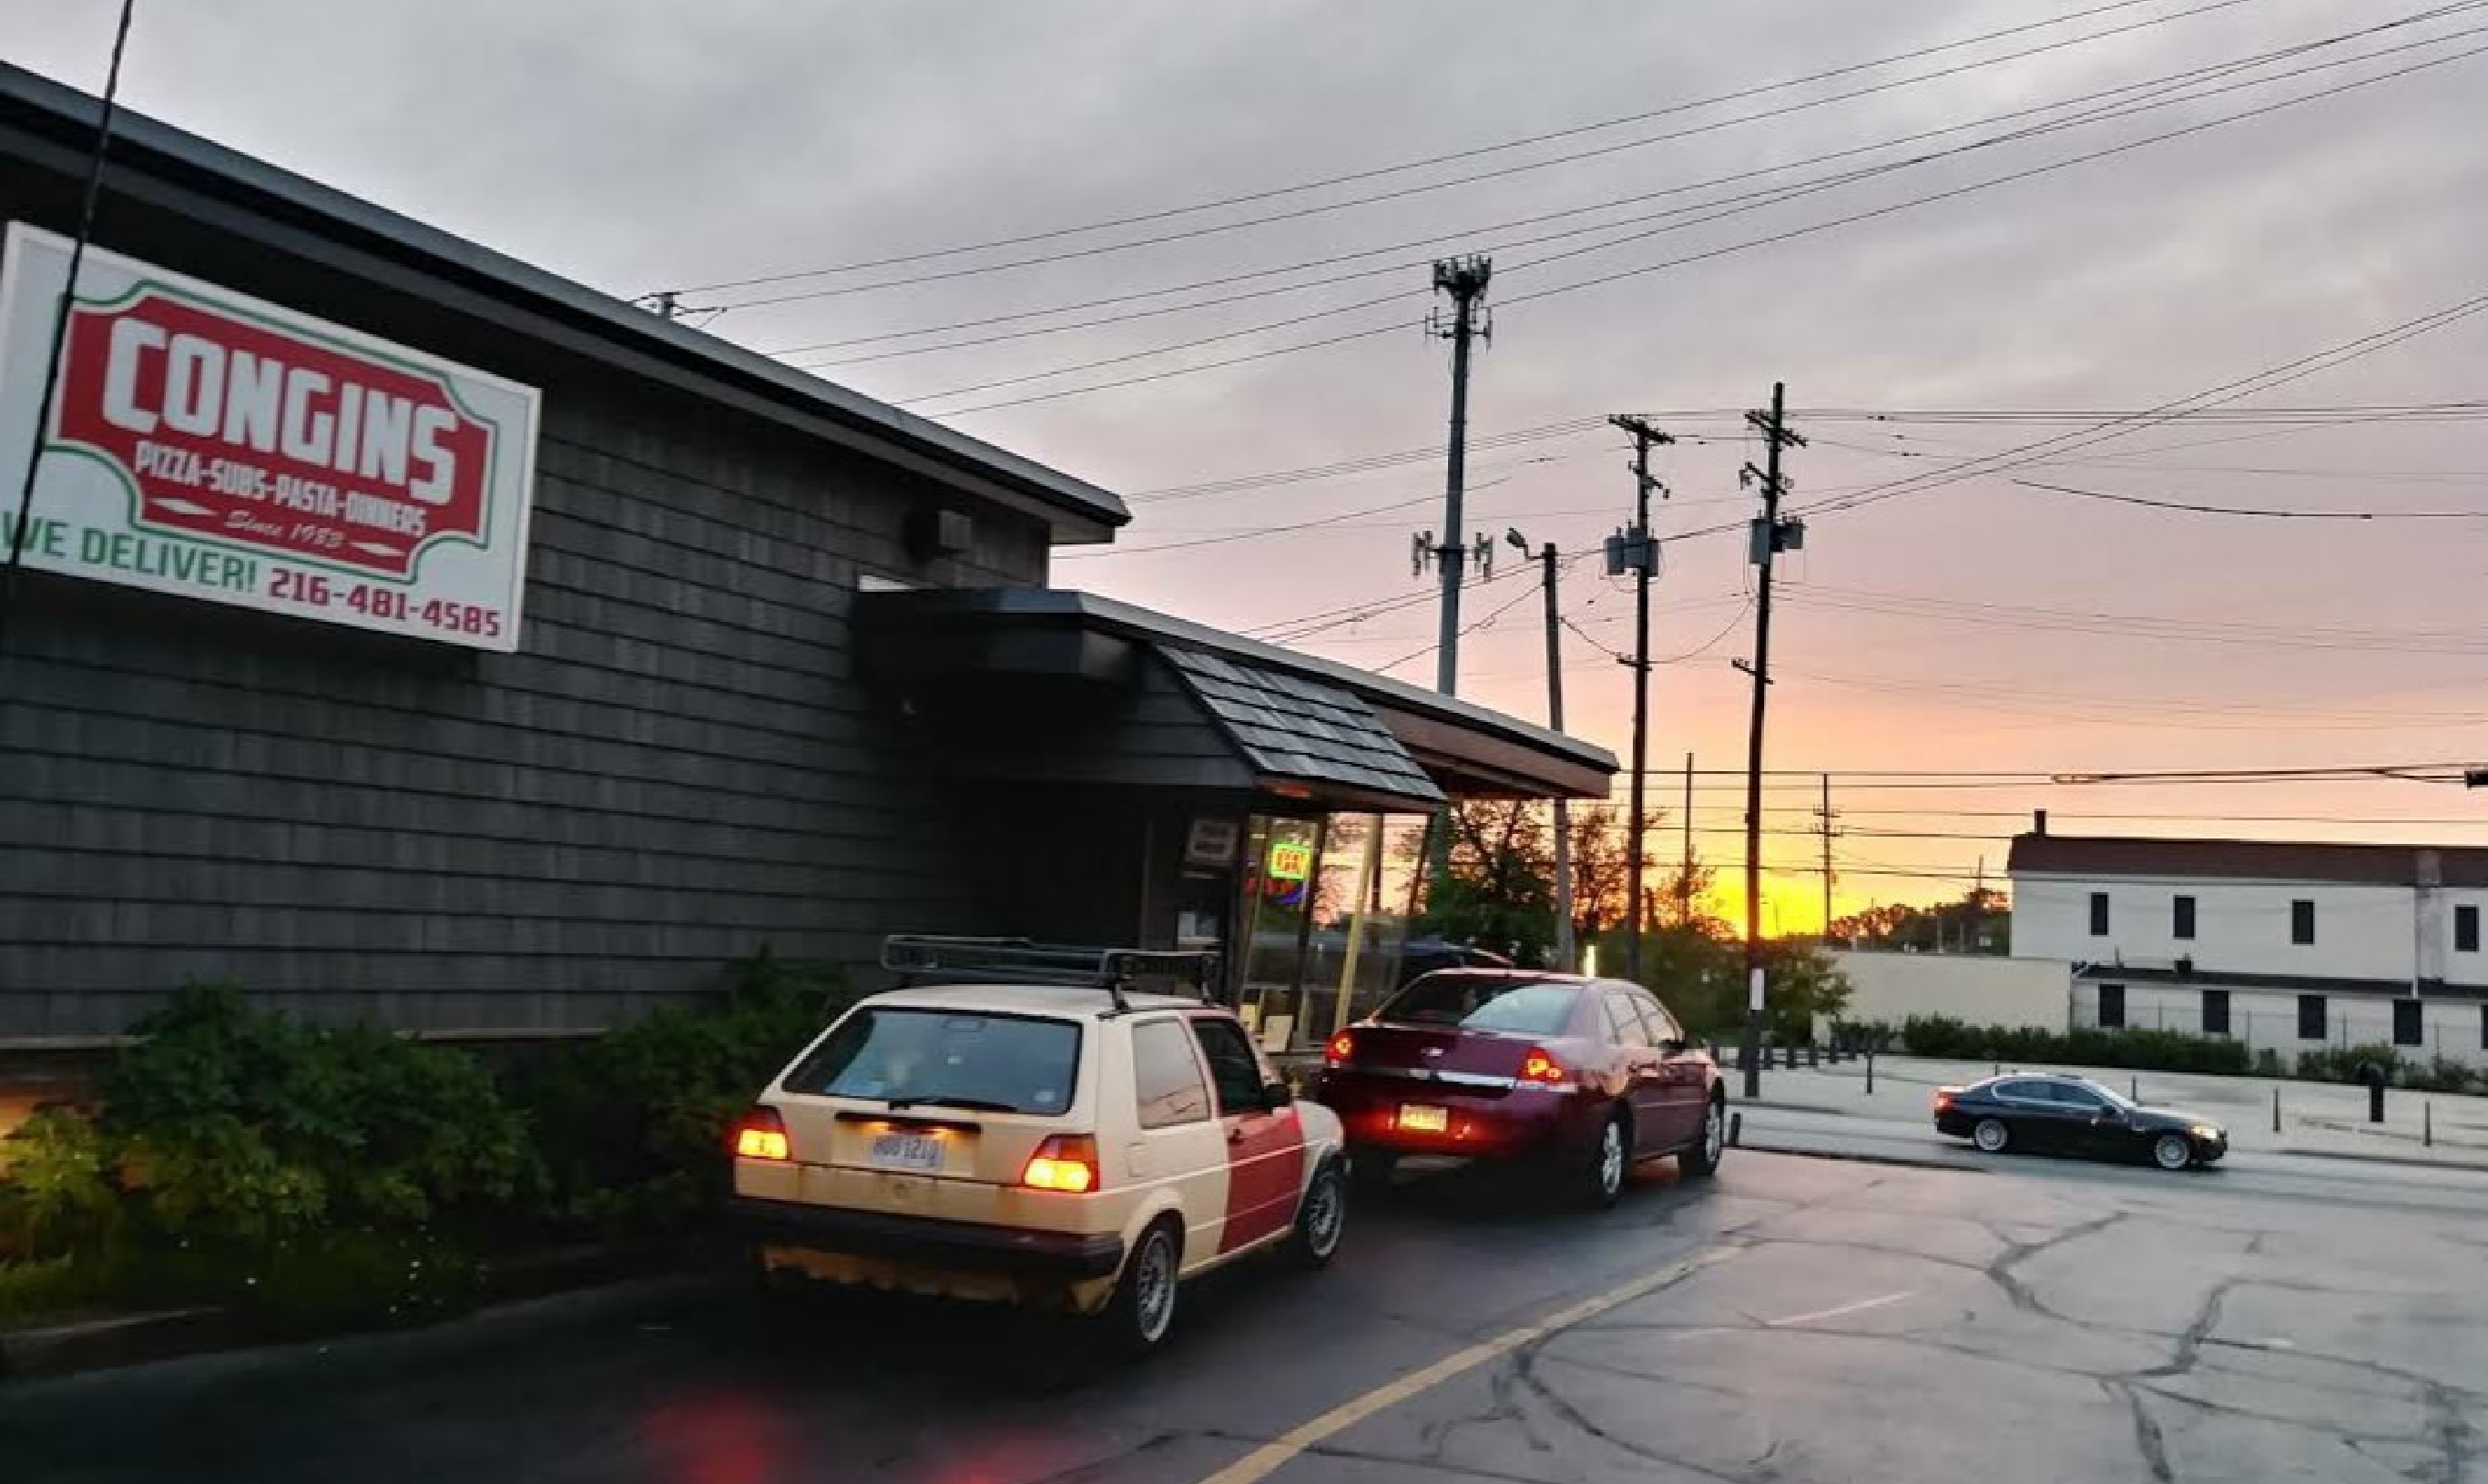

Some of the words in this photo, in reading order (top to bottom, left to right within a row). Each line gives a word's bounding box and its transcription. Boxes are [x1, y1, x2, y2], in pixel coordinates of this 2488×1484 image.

[103, 317, 456, 505] CONGINS
[3, 511, 69, 558] WE
[81, 527, 258, 593] DELIVER!
[269, 567, 501, 636] 216-481-4585
[224, 509, 282, 536] Since
